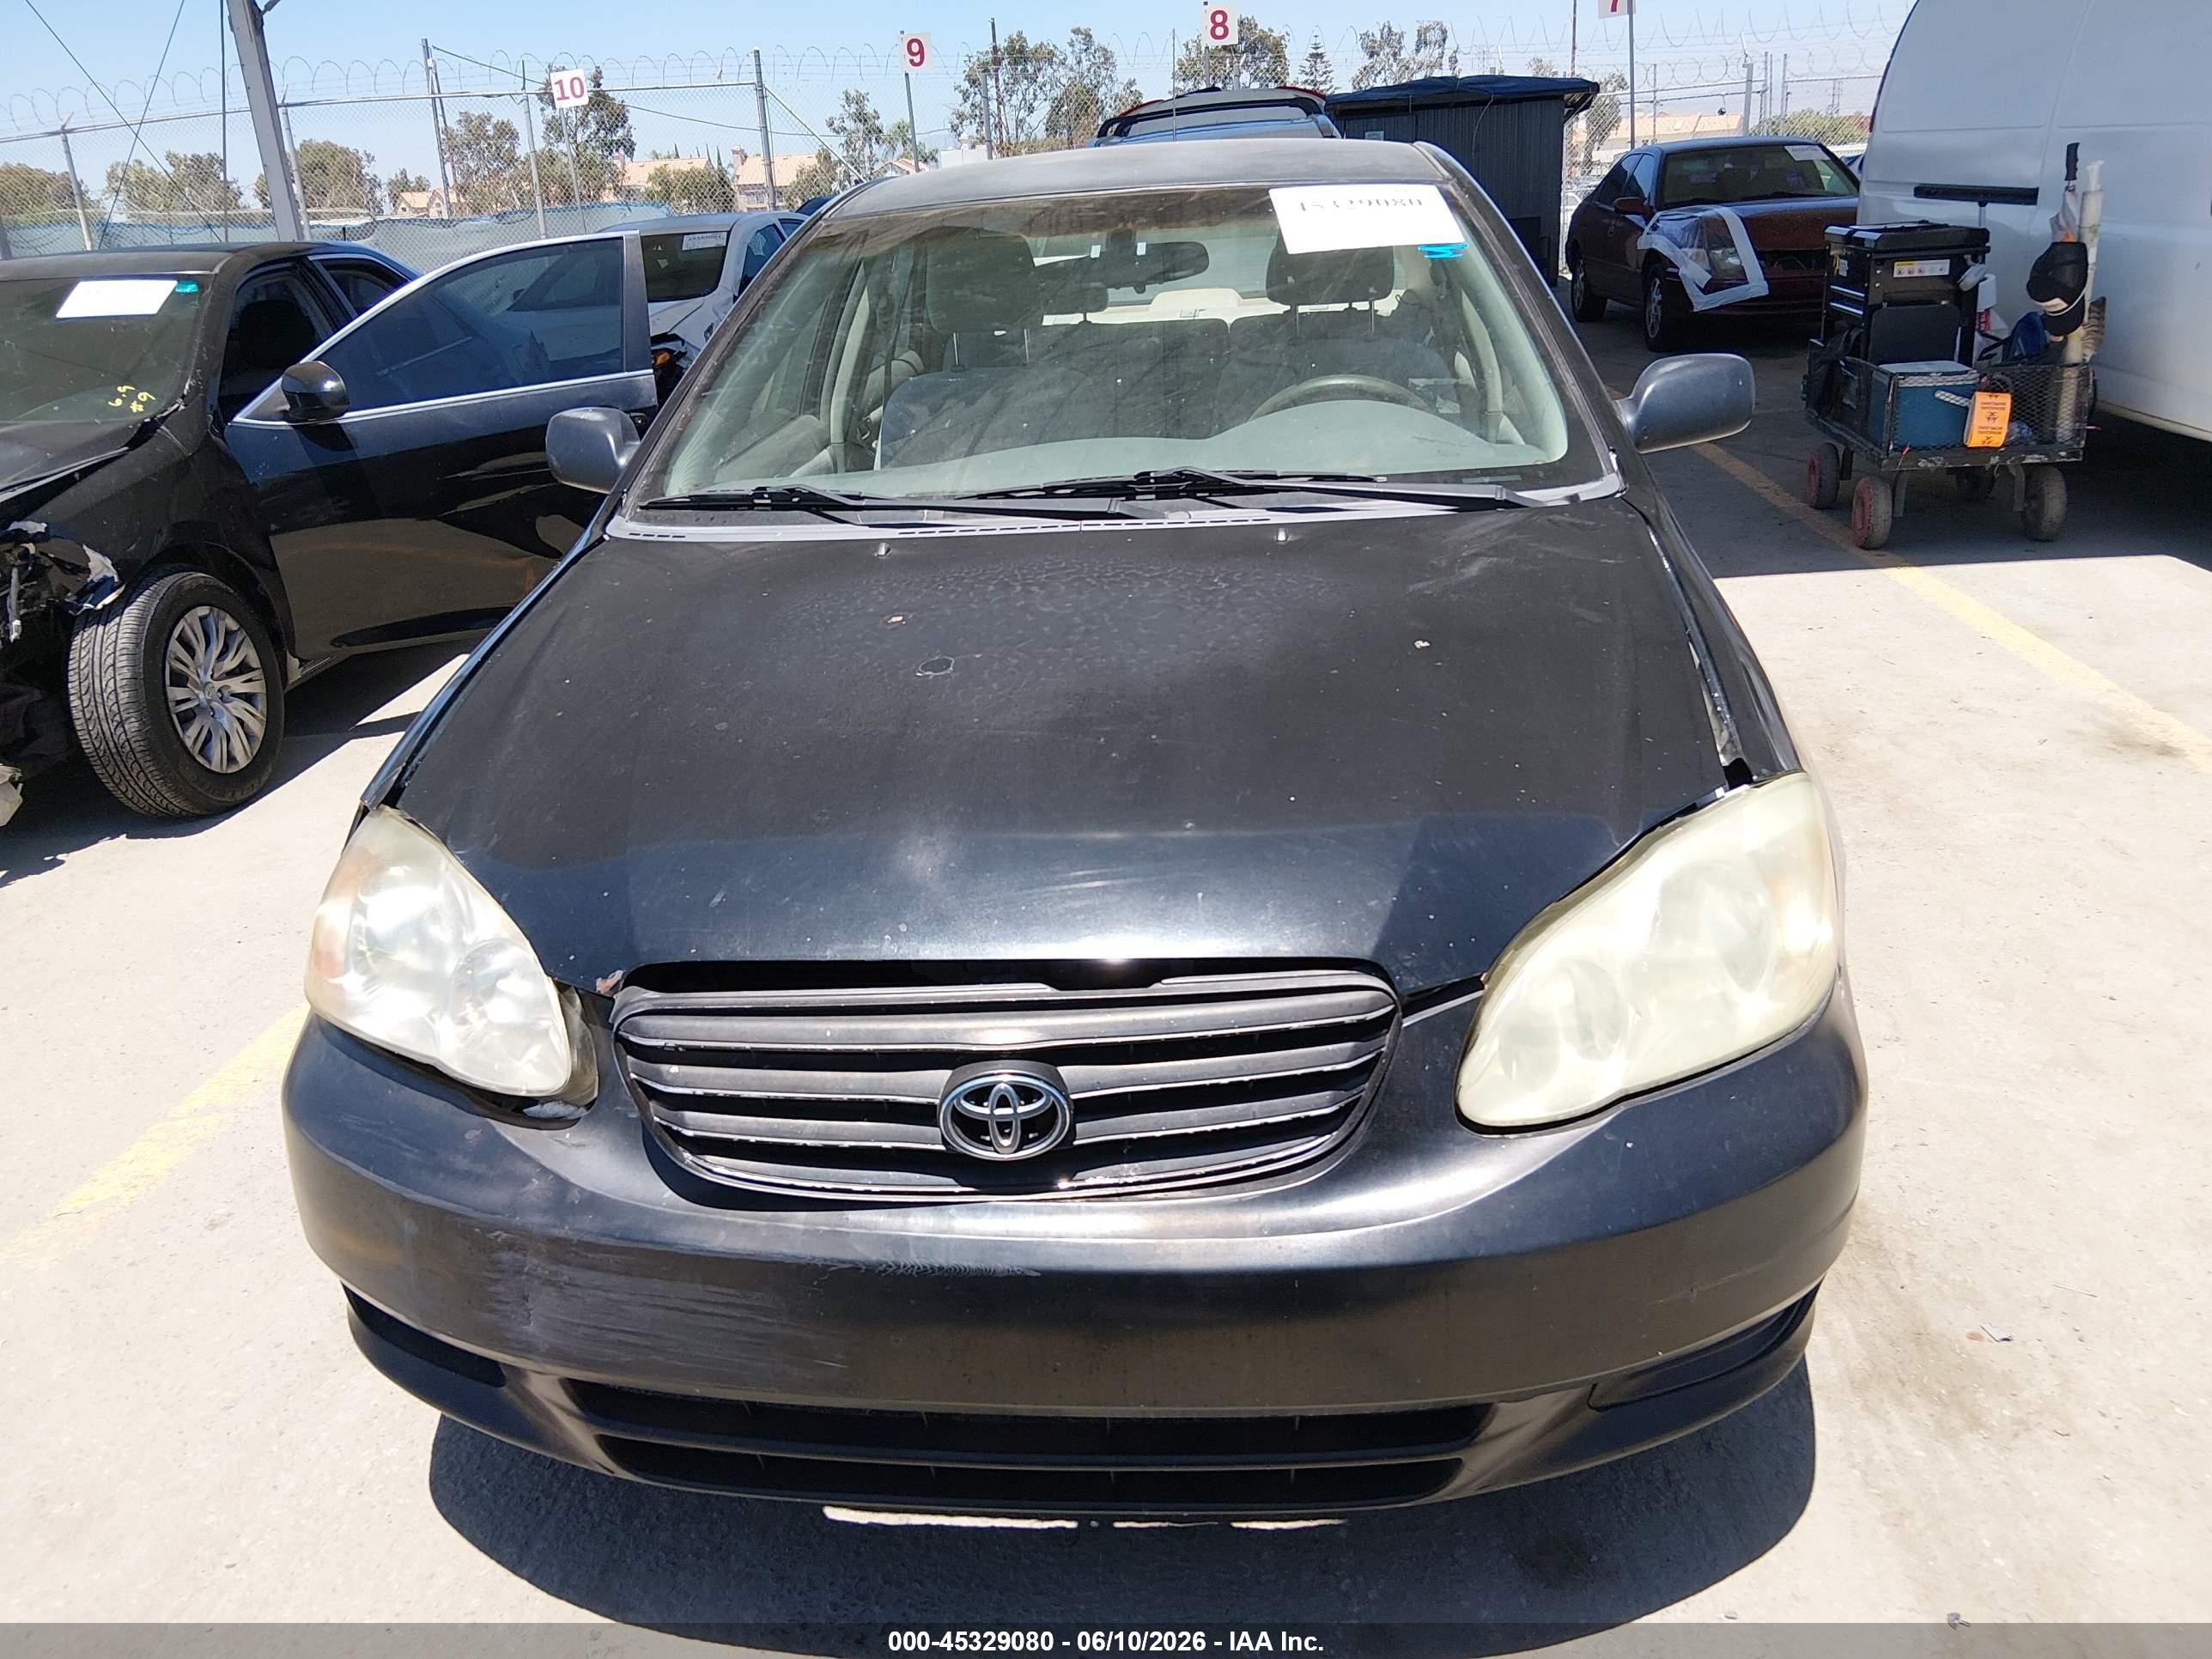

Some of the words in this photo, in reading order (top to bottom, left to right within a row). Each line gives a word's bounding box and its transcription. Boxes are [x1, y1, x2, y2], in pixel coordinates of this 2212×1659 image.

[1210, 9, 1230, 40] 8
[906, 38, 926, 67] 9
[554, 76, 584, 100] 10
